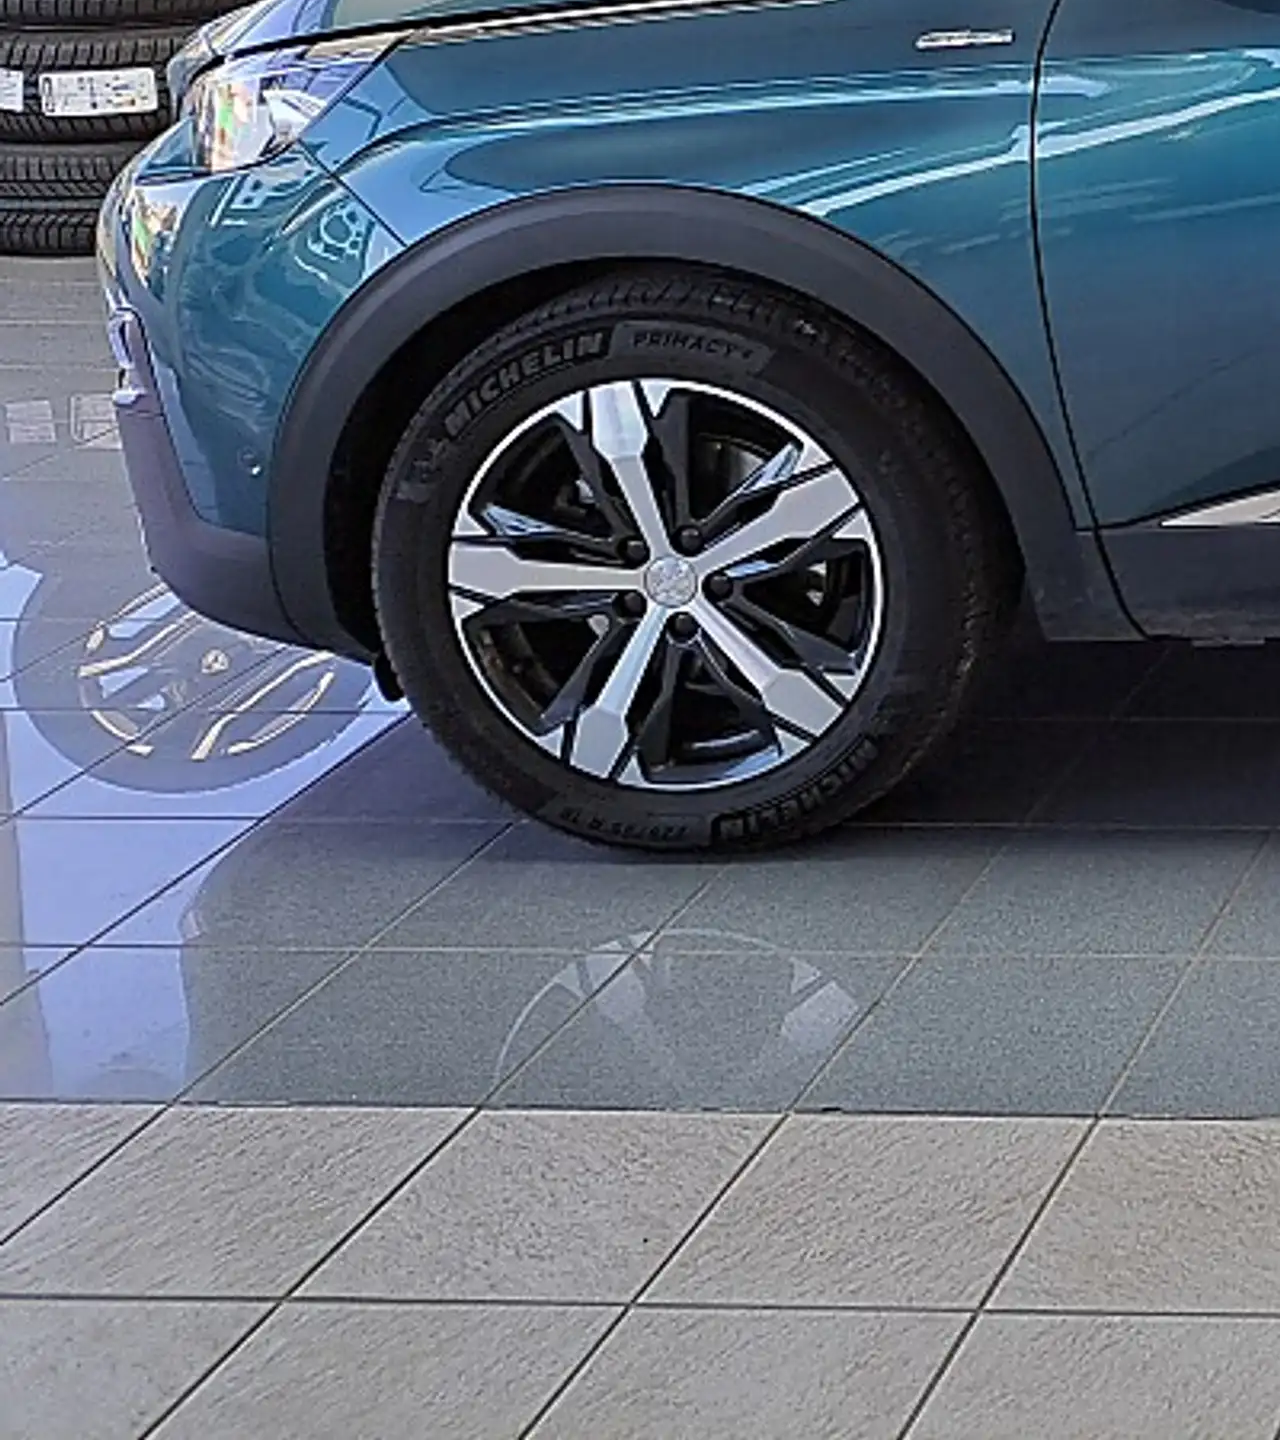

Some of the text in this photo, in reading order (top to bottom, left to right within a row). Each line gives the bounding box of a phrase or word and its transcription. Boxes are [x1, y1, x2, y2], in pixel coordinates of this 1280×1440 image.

[445, 332, 602, 435] MICHELIN
[633, 329, 735, 358] PRIMACY
[719, 740, 879, 841] MICHELIN
